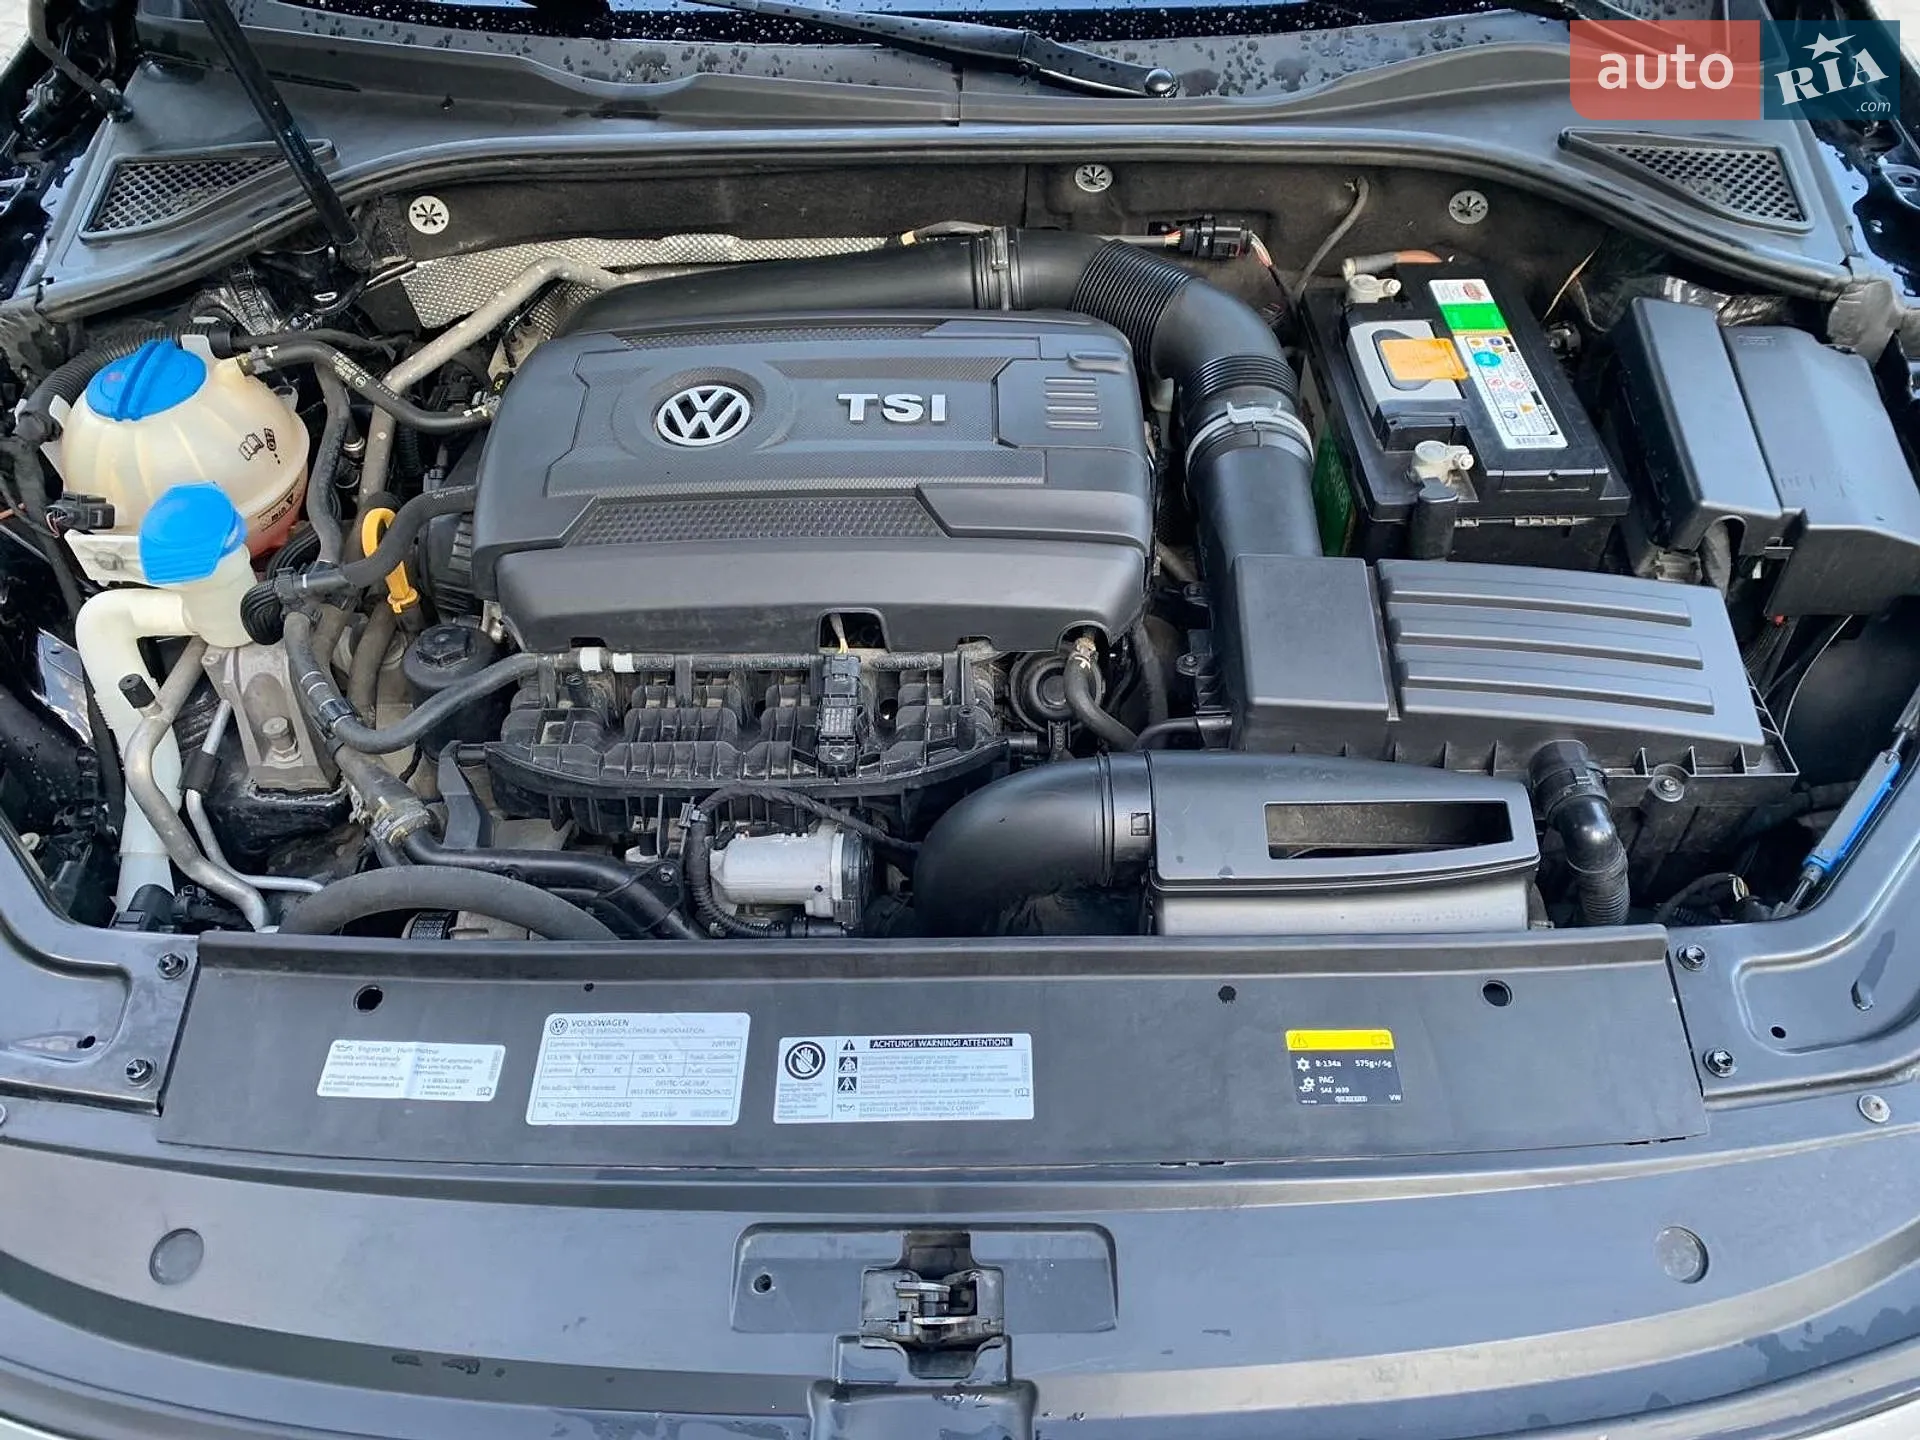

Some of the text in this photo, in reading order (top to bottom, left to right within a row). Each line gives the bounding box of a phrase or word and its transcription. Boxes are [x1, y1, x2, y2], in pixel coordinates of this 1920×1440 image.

[837, 393, 948, 424] TSI
[570, 1019, 630, 1027] VOLKSWAGEN
[872, 1038, 1010, 1049] ACHTUNG! WARNING! ATTENTION!
